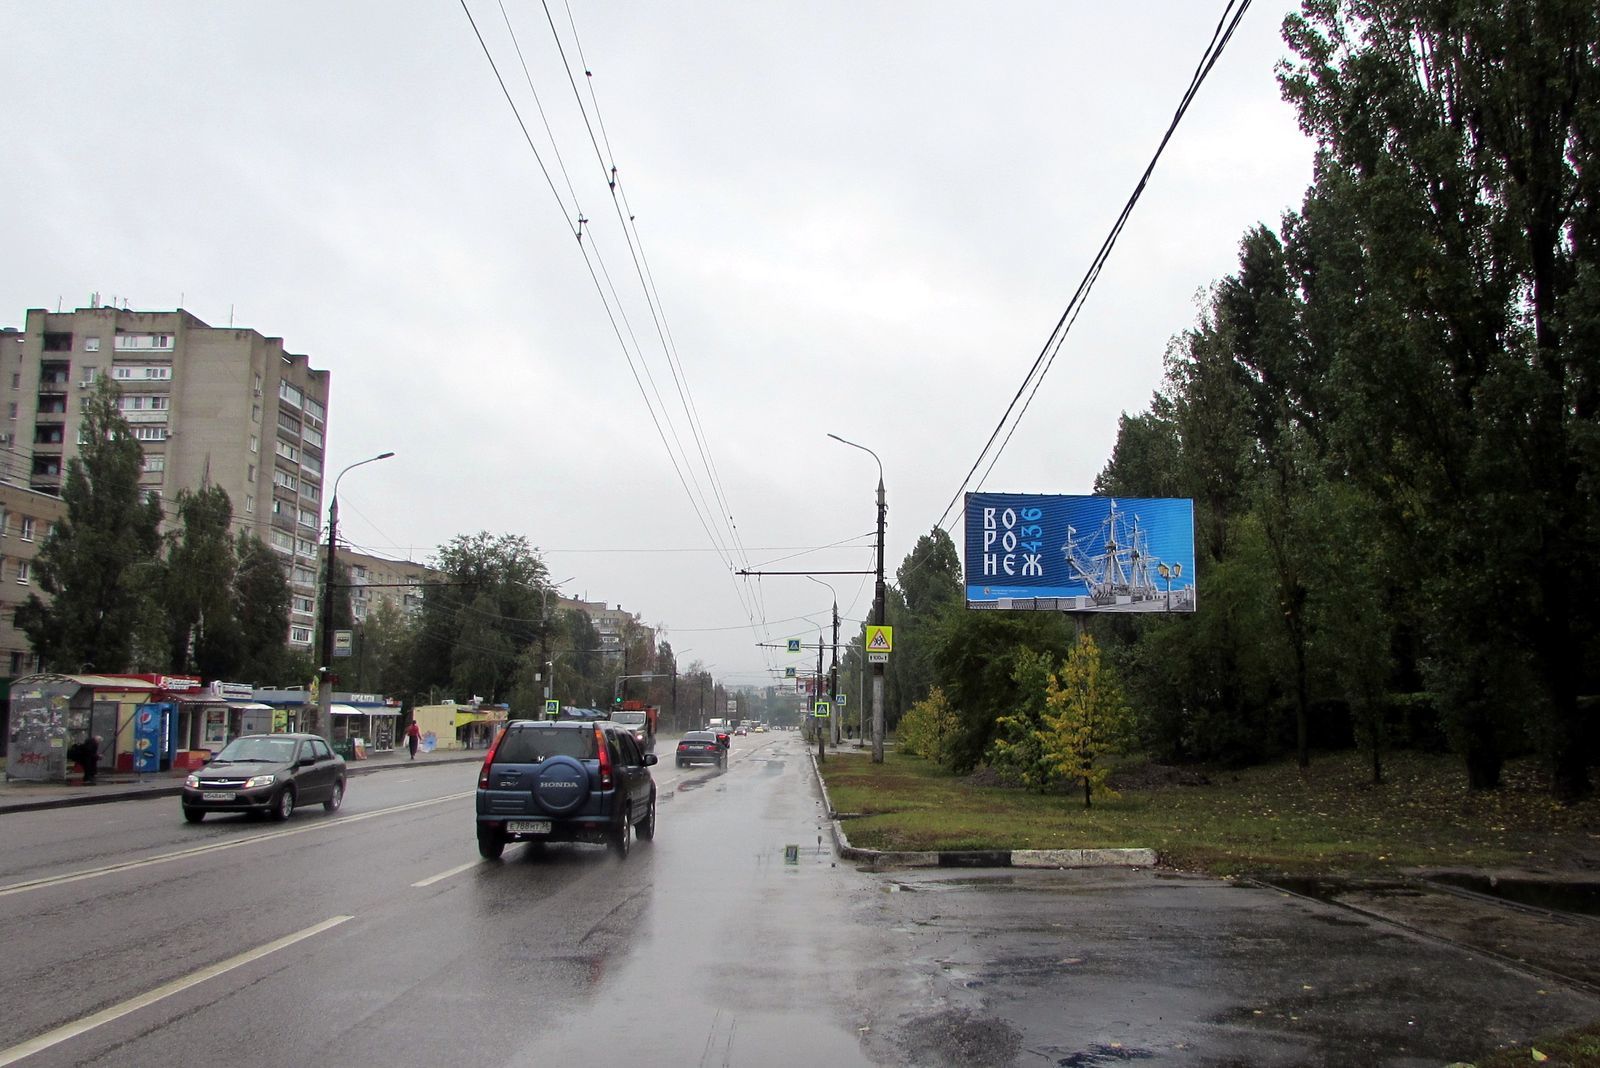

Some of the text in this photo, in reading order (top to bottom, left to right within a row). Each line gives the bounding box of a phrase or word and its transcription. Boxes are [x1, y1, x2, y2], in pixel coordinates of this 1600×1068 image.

[984, 507, 1017, 529] ВО
[984, 530, 1017, 552] РО
[1020, 507, 1043, 553] 436
